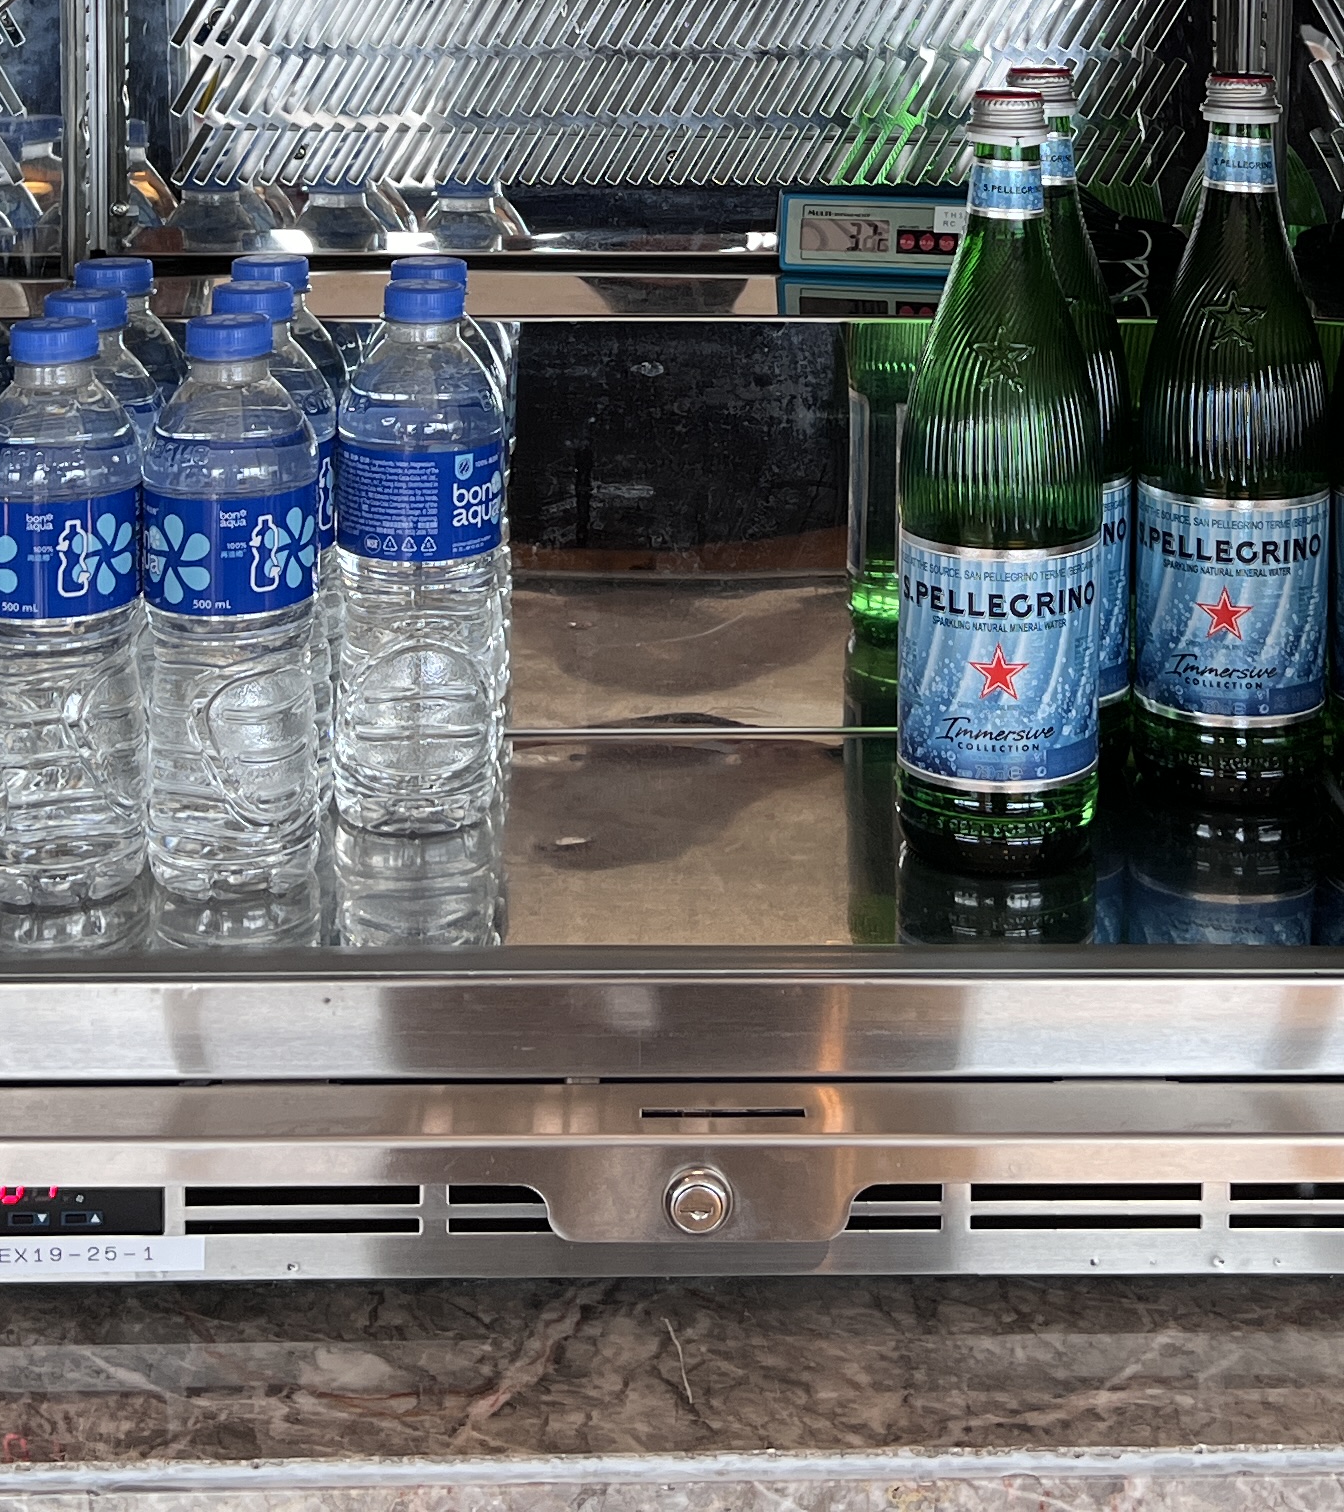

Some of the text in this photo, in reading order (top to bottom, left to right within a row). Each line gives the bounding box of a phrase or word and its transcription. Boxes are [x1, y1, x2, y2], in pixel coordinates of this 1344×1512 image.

[453, 482, 493, 508] bon
[25, 512, 47, 523] bon
[219, 510, 241, 520] bon
[452, 494, 502, 529] aqua
[25, 522, 54, 533] aqua
[219, 518, 248, 529] aqua
[1193, 516, 1210, 528] SAN
[1211, 519, 1265, 530] PELLEGRINO
[1139, 521, 1322, 567] S.PELLEGRINO
[963, 570, 982, 581] SAN
[983, 571, 1039, 583] PELLEGRINO
[1199, 565, 1234, 578] NATURAL
[1268, 566, 1292, 577] WATER
[902, 574, 1096, 621] S.PELLEGRINO
[1, 601, 39, 613] 500 mL
[192, 600, 232, 610] 500 mL
[931, 615, 971, 631] SPARKLING
[971, 621, 1008, 633] NATURAL
[1043, 618, 1068, 631] WATER
[1164, 653, 1280, 680] Immersive
[1184, 676, 1264, 691] COLLECTION
[935, 716, 1056, 743] Immersive
[957, 741, 1041, 754] COLLECTION
